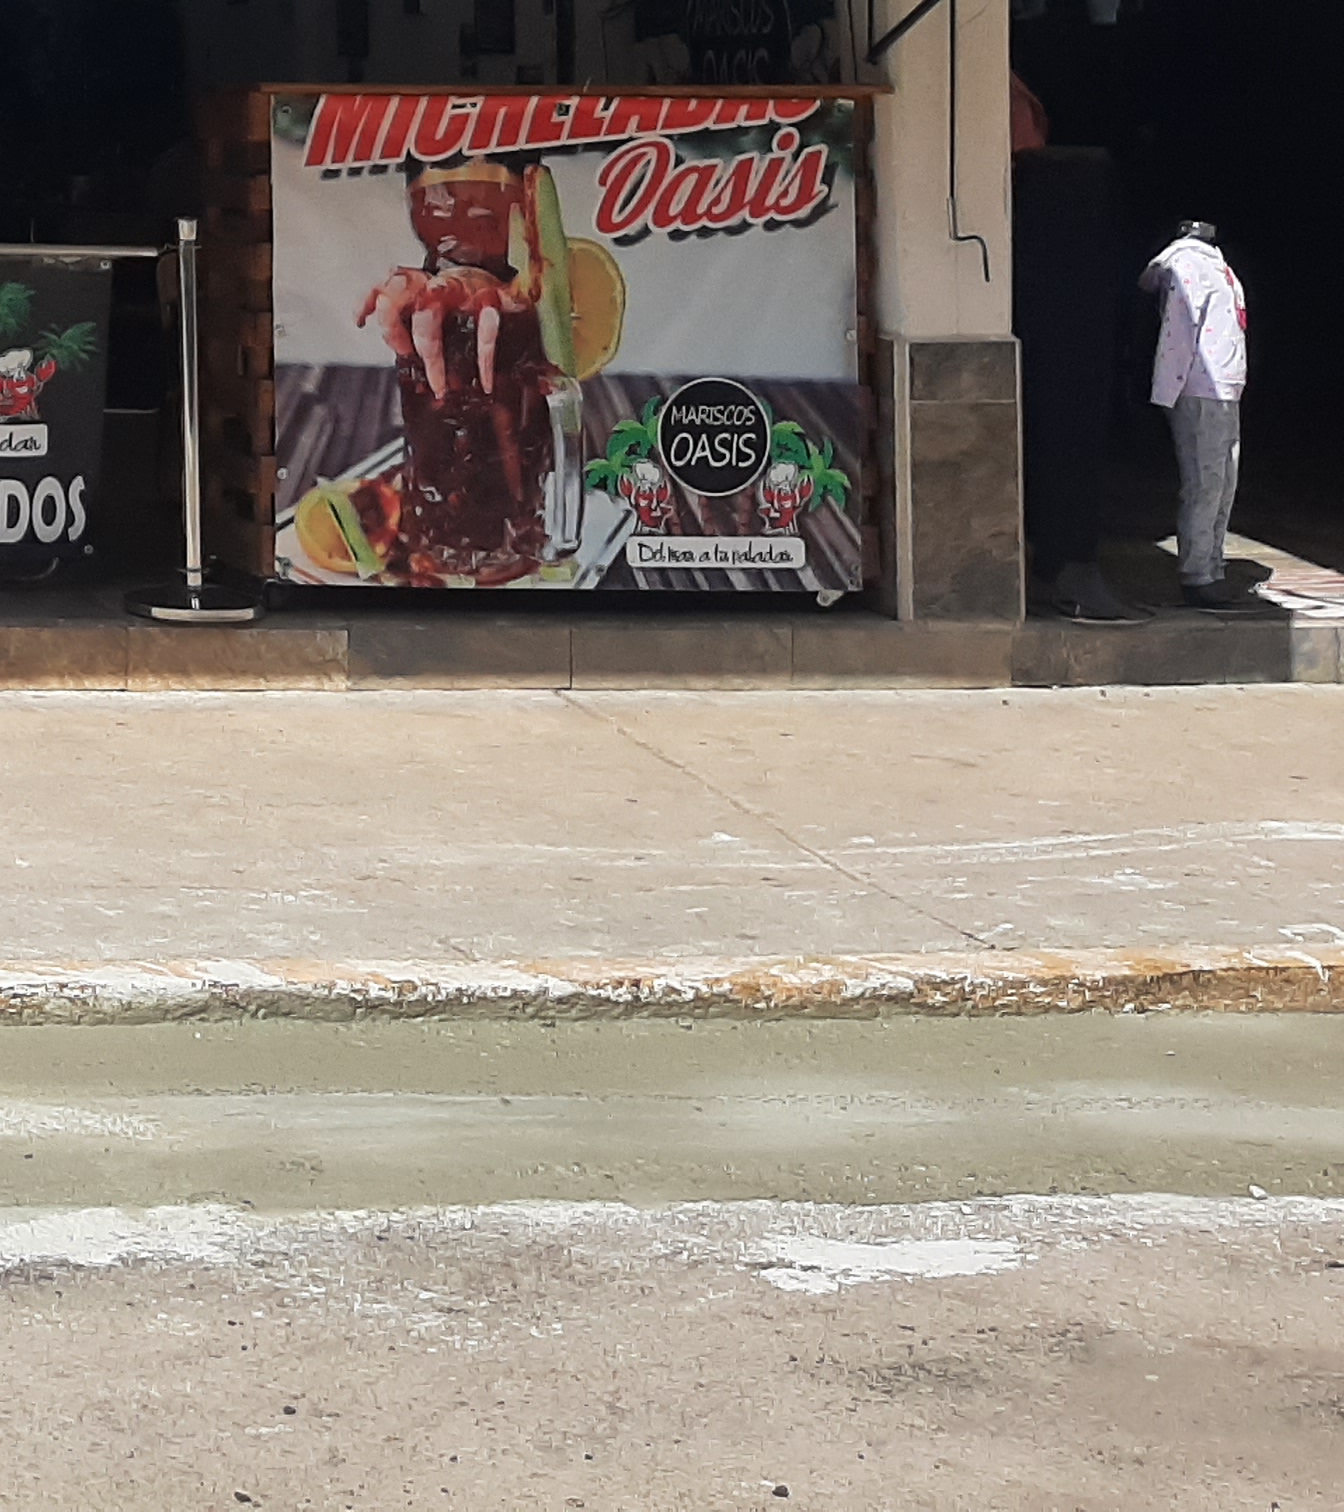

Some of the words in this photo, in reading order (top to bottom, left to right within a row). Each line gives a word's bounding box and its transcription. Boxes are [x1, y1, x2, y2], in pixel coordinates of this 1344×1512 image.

[305, 95, 820, 167] MICHEL
[596, 128, 828, 235] Oasis
[671, 405, 756, 426] MARISCOS
[670, 432, 757, 468] OASIS
